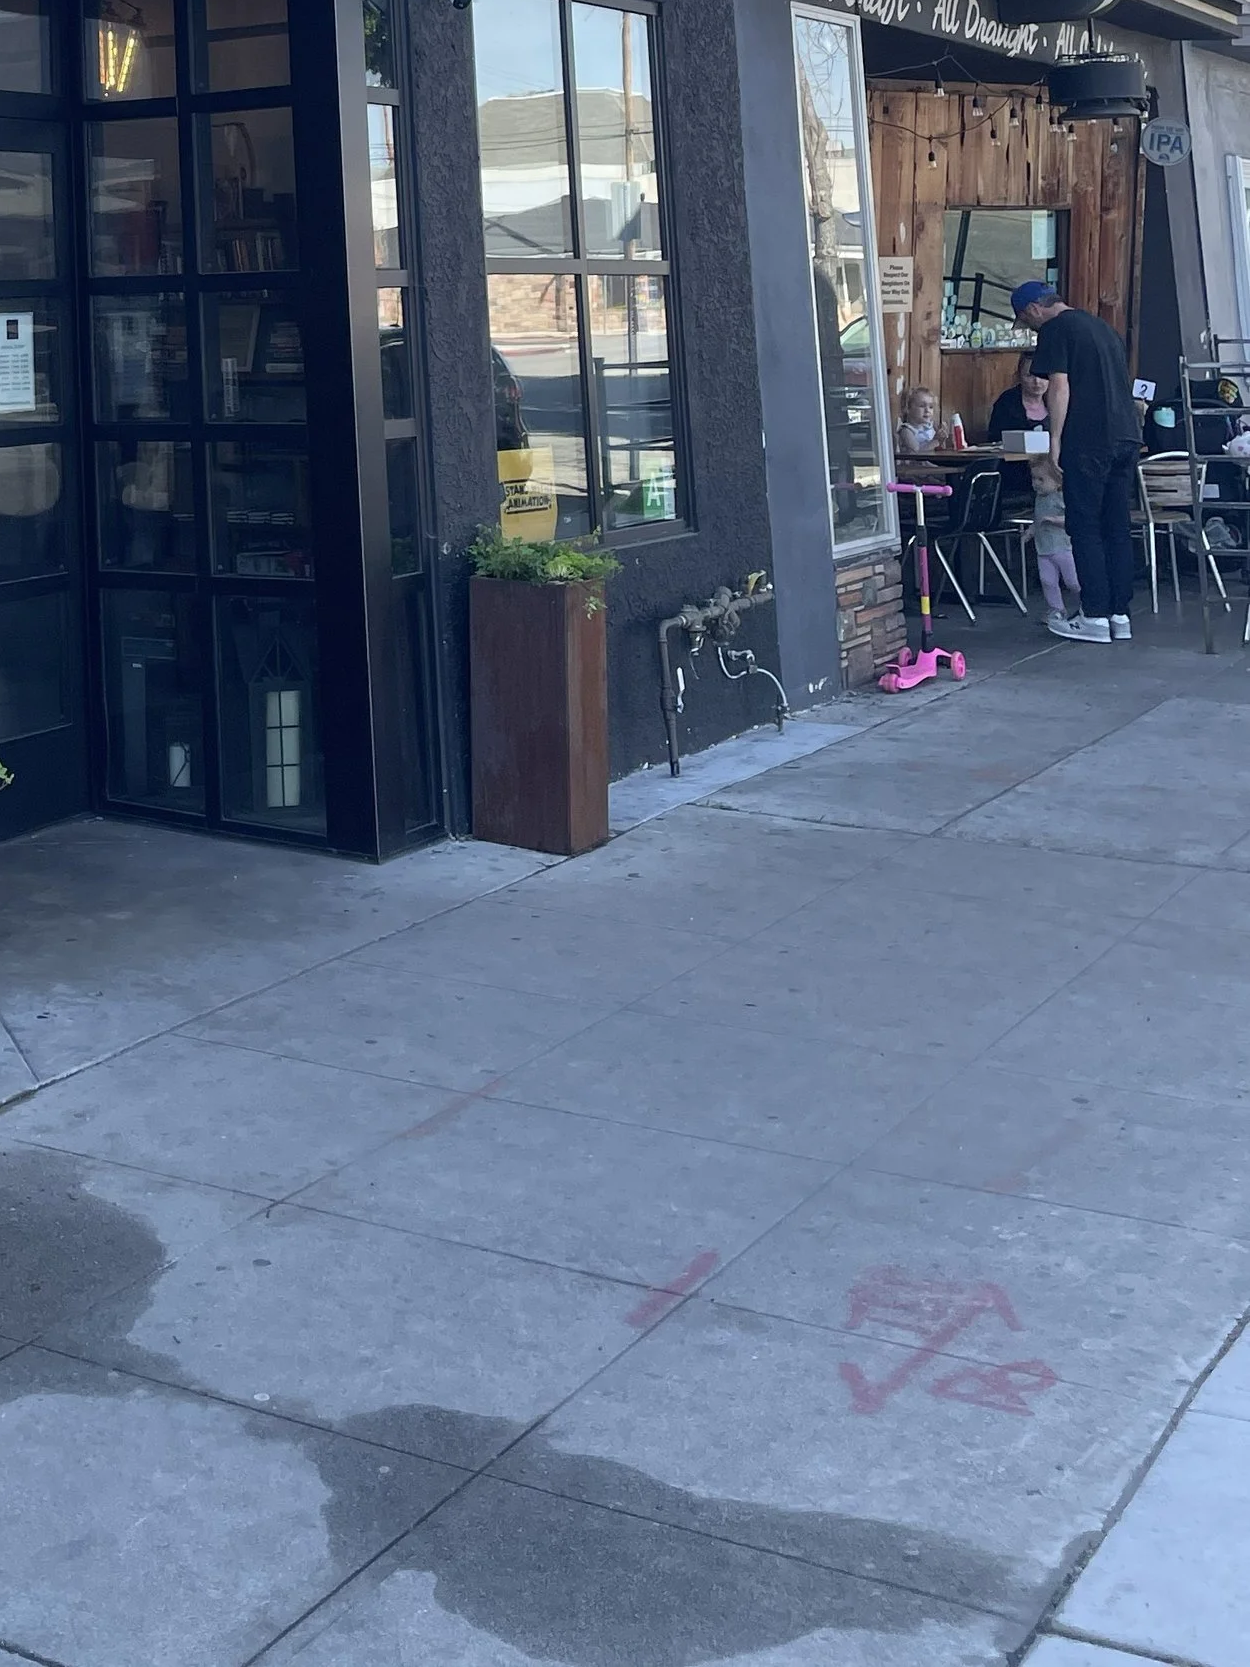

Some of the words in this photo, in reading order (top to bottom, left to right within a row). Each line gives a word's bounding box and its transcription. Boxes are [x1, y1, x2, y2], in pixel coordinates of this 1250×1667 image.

[1148, 132, 1184, 155] IPA
[1140, 384, 1148, 396] 2
[646, 471, 662, 507] A
